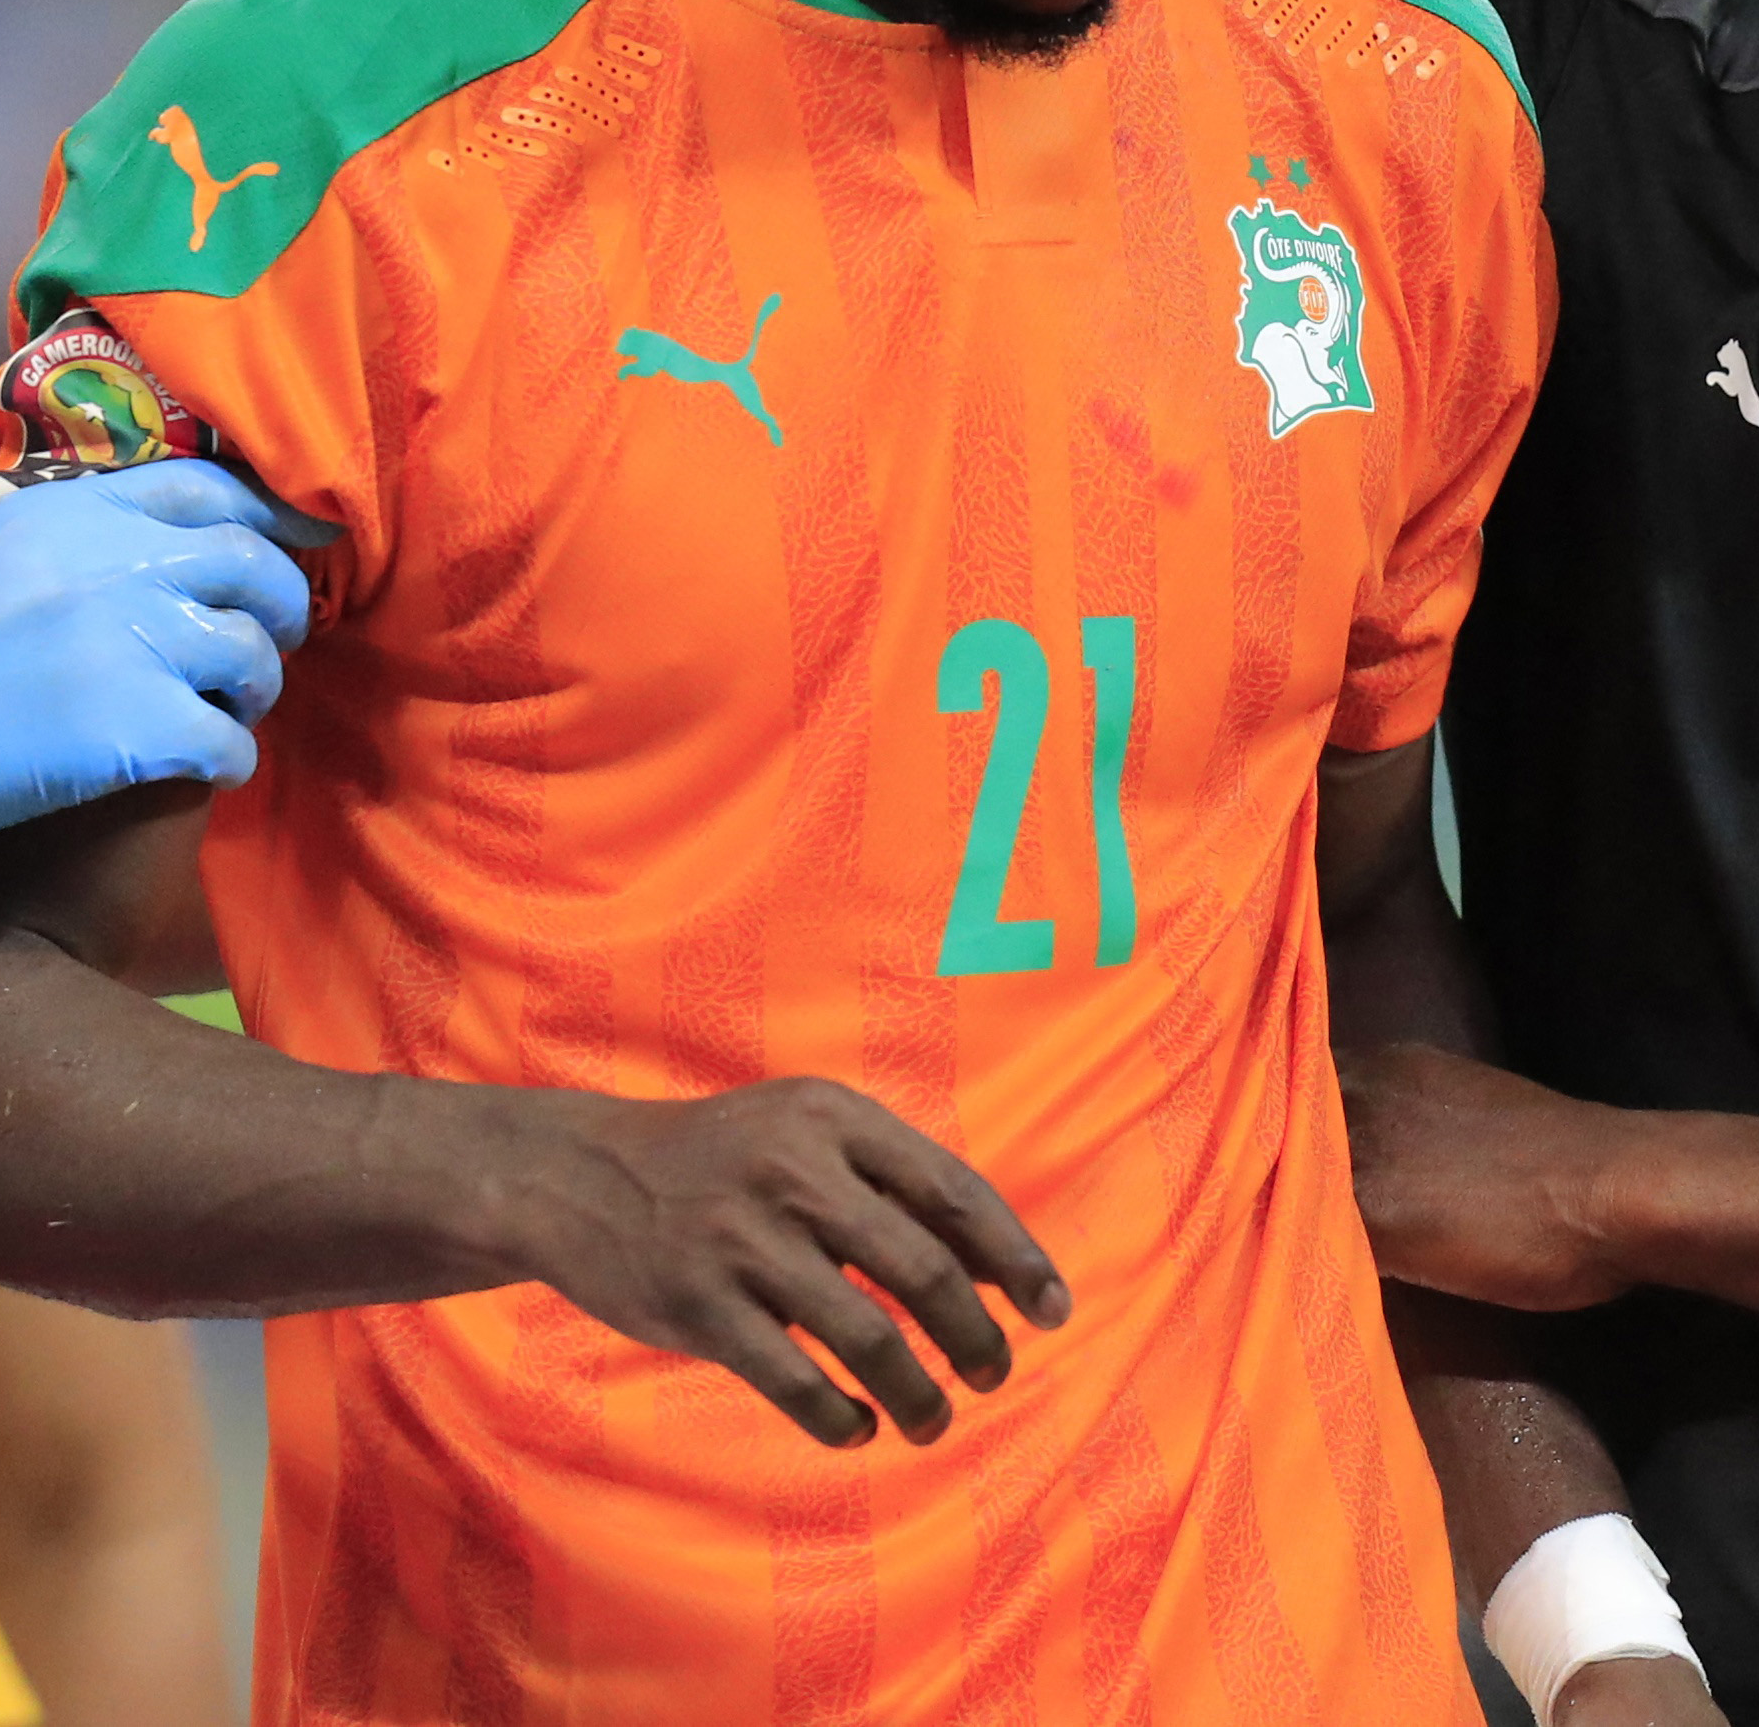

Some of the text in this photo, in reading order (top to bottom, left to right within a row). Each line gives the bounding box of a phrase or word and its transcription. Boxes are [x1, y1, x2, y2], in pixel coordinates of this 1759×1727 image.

[1294, 239, 1346, 278] D'IVOIRE
[21, 333, 143, 388] CAMEROON
[936, 616, 1136, 977] 21
